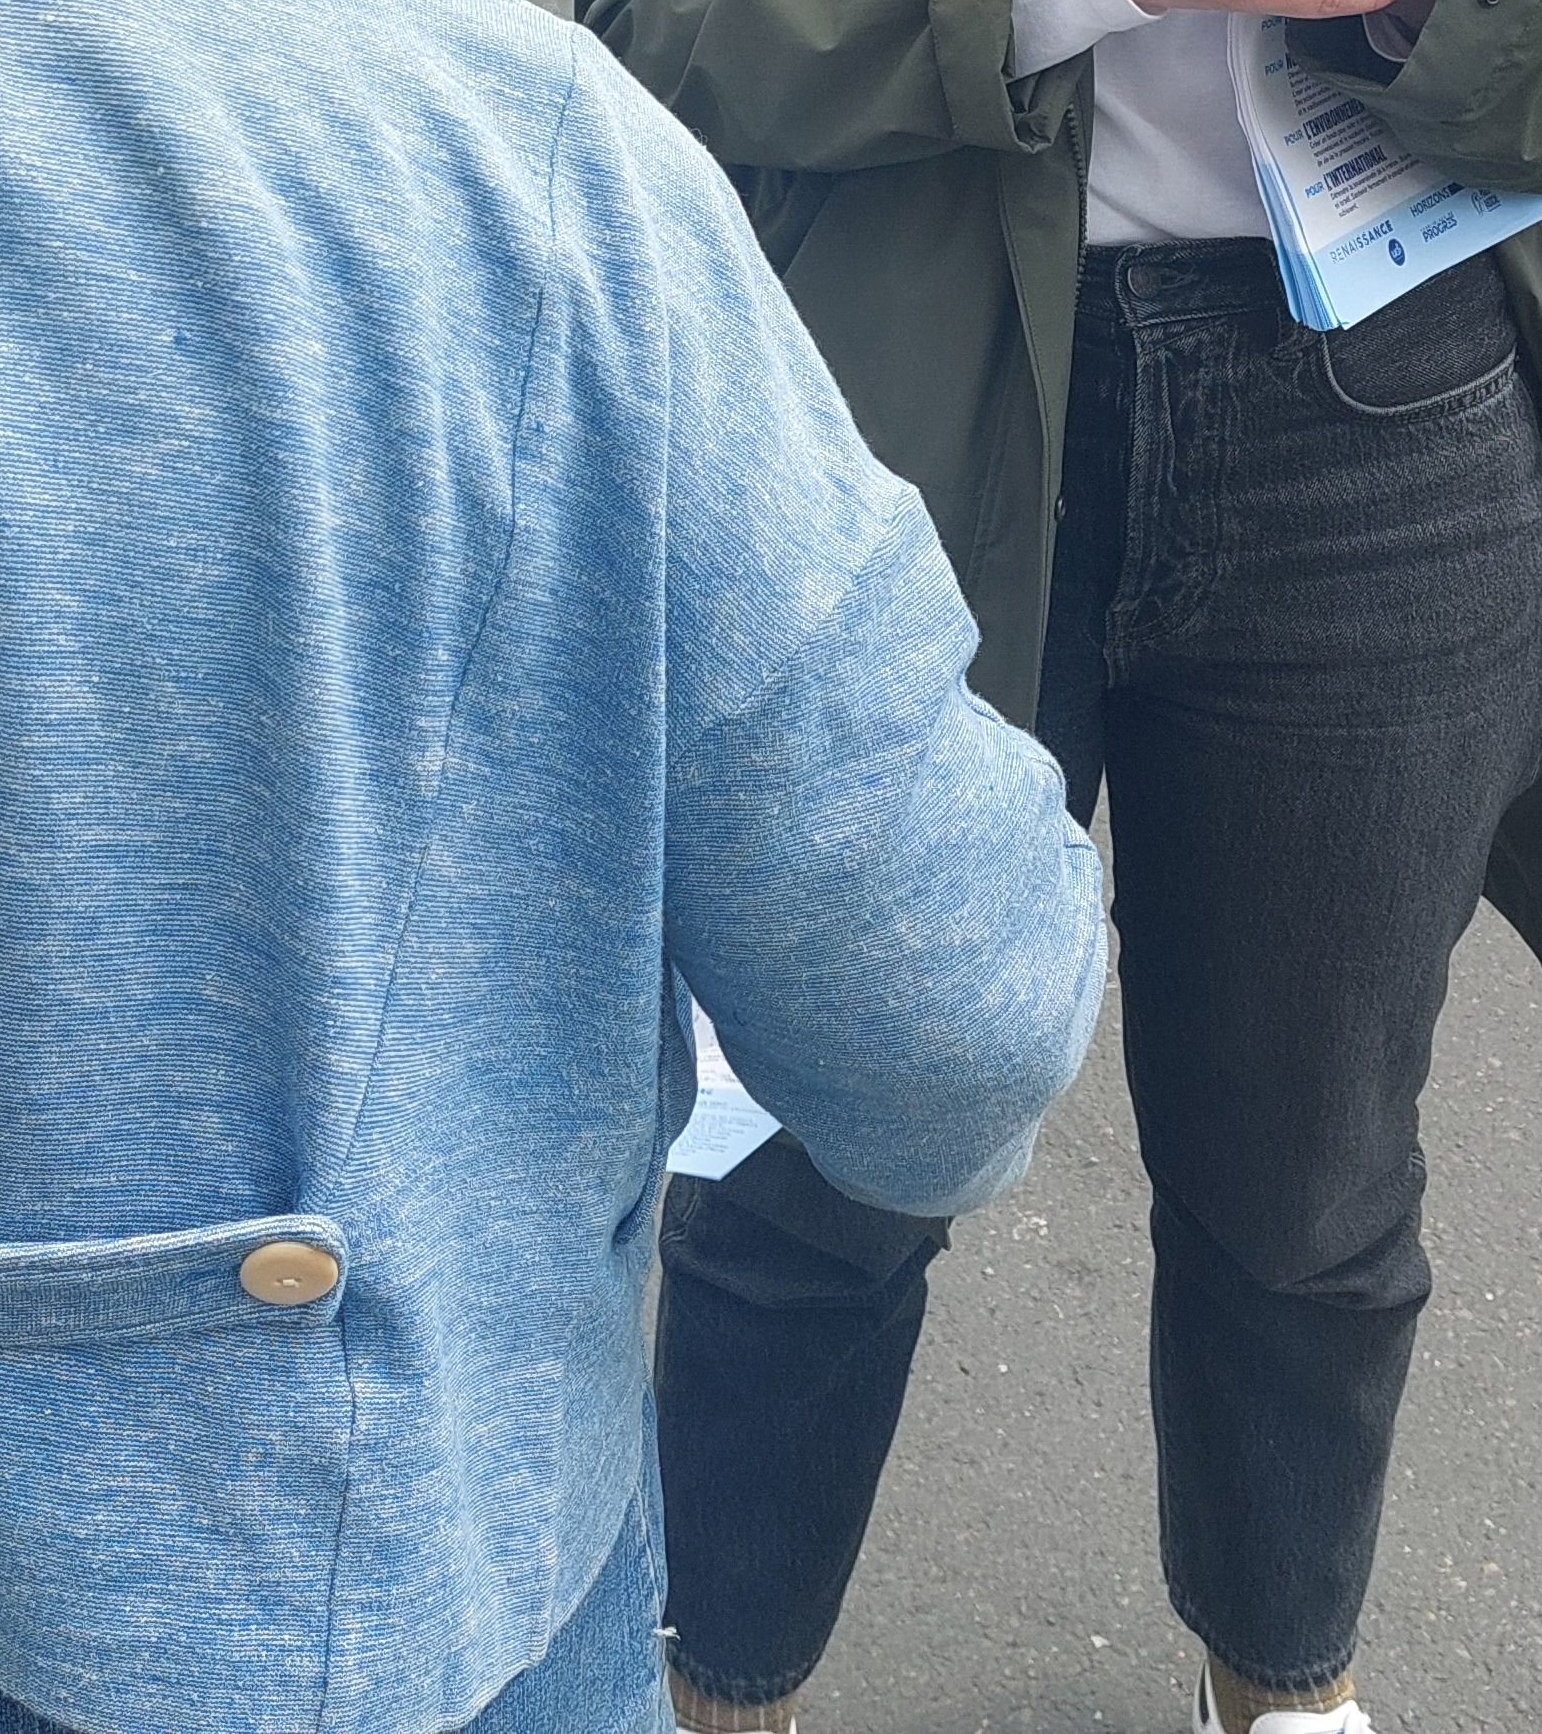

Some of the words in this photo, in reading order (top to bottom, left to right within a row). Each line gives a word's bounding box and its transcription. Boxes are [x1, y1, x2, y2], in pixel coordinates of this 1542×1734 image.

[1283, 128, 1304, 147] POUR
[1304, 181, 1325, 199] POUR
[1322, 144, 1388, 192] L'INTERNATIONAL
[1409, 186, 1451, 218] HORIZONS
[1328, 219, 1394, 264] RENAISSANCE
